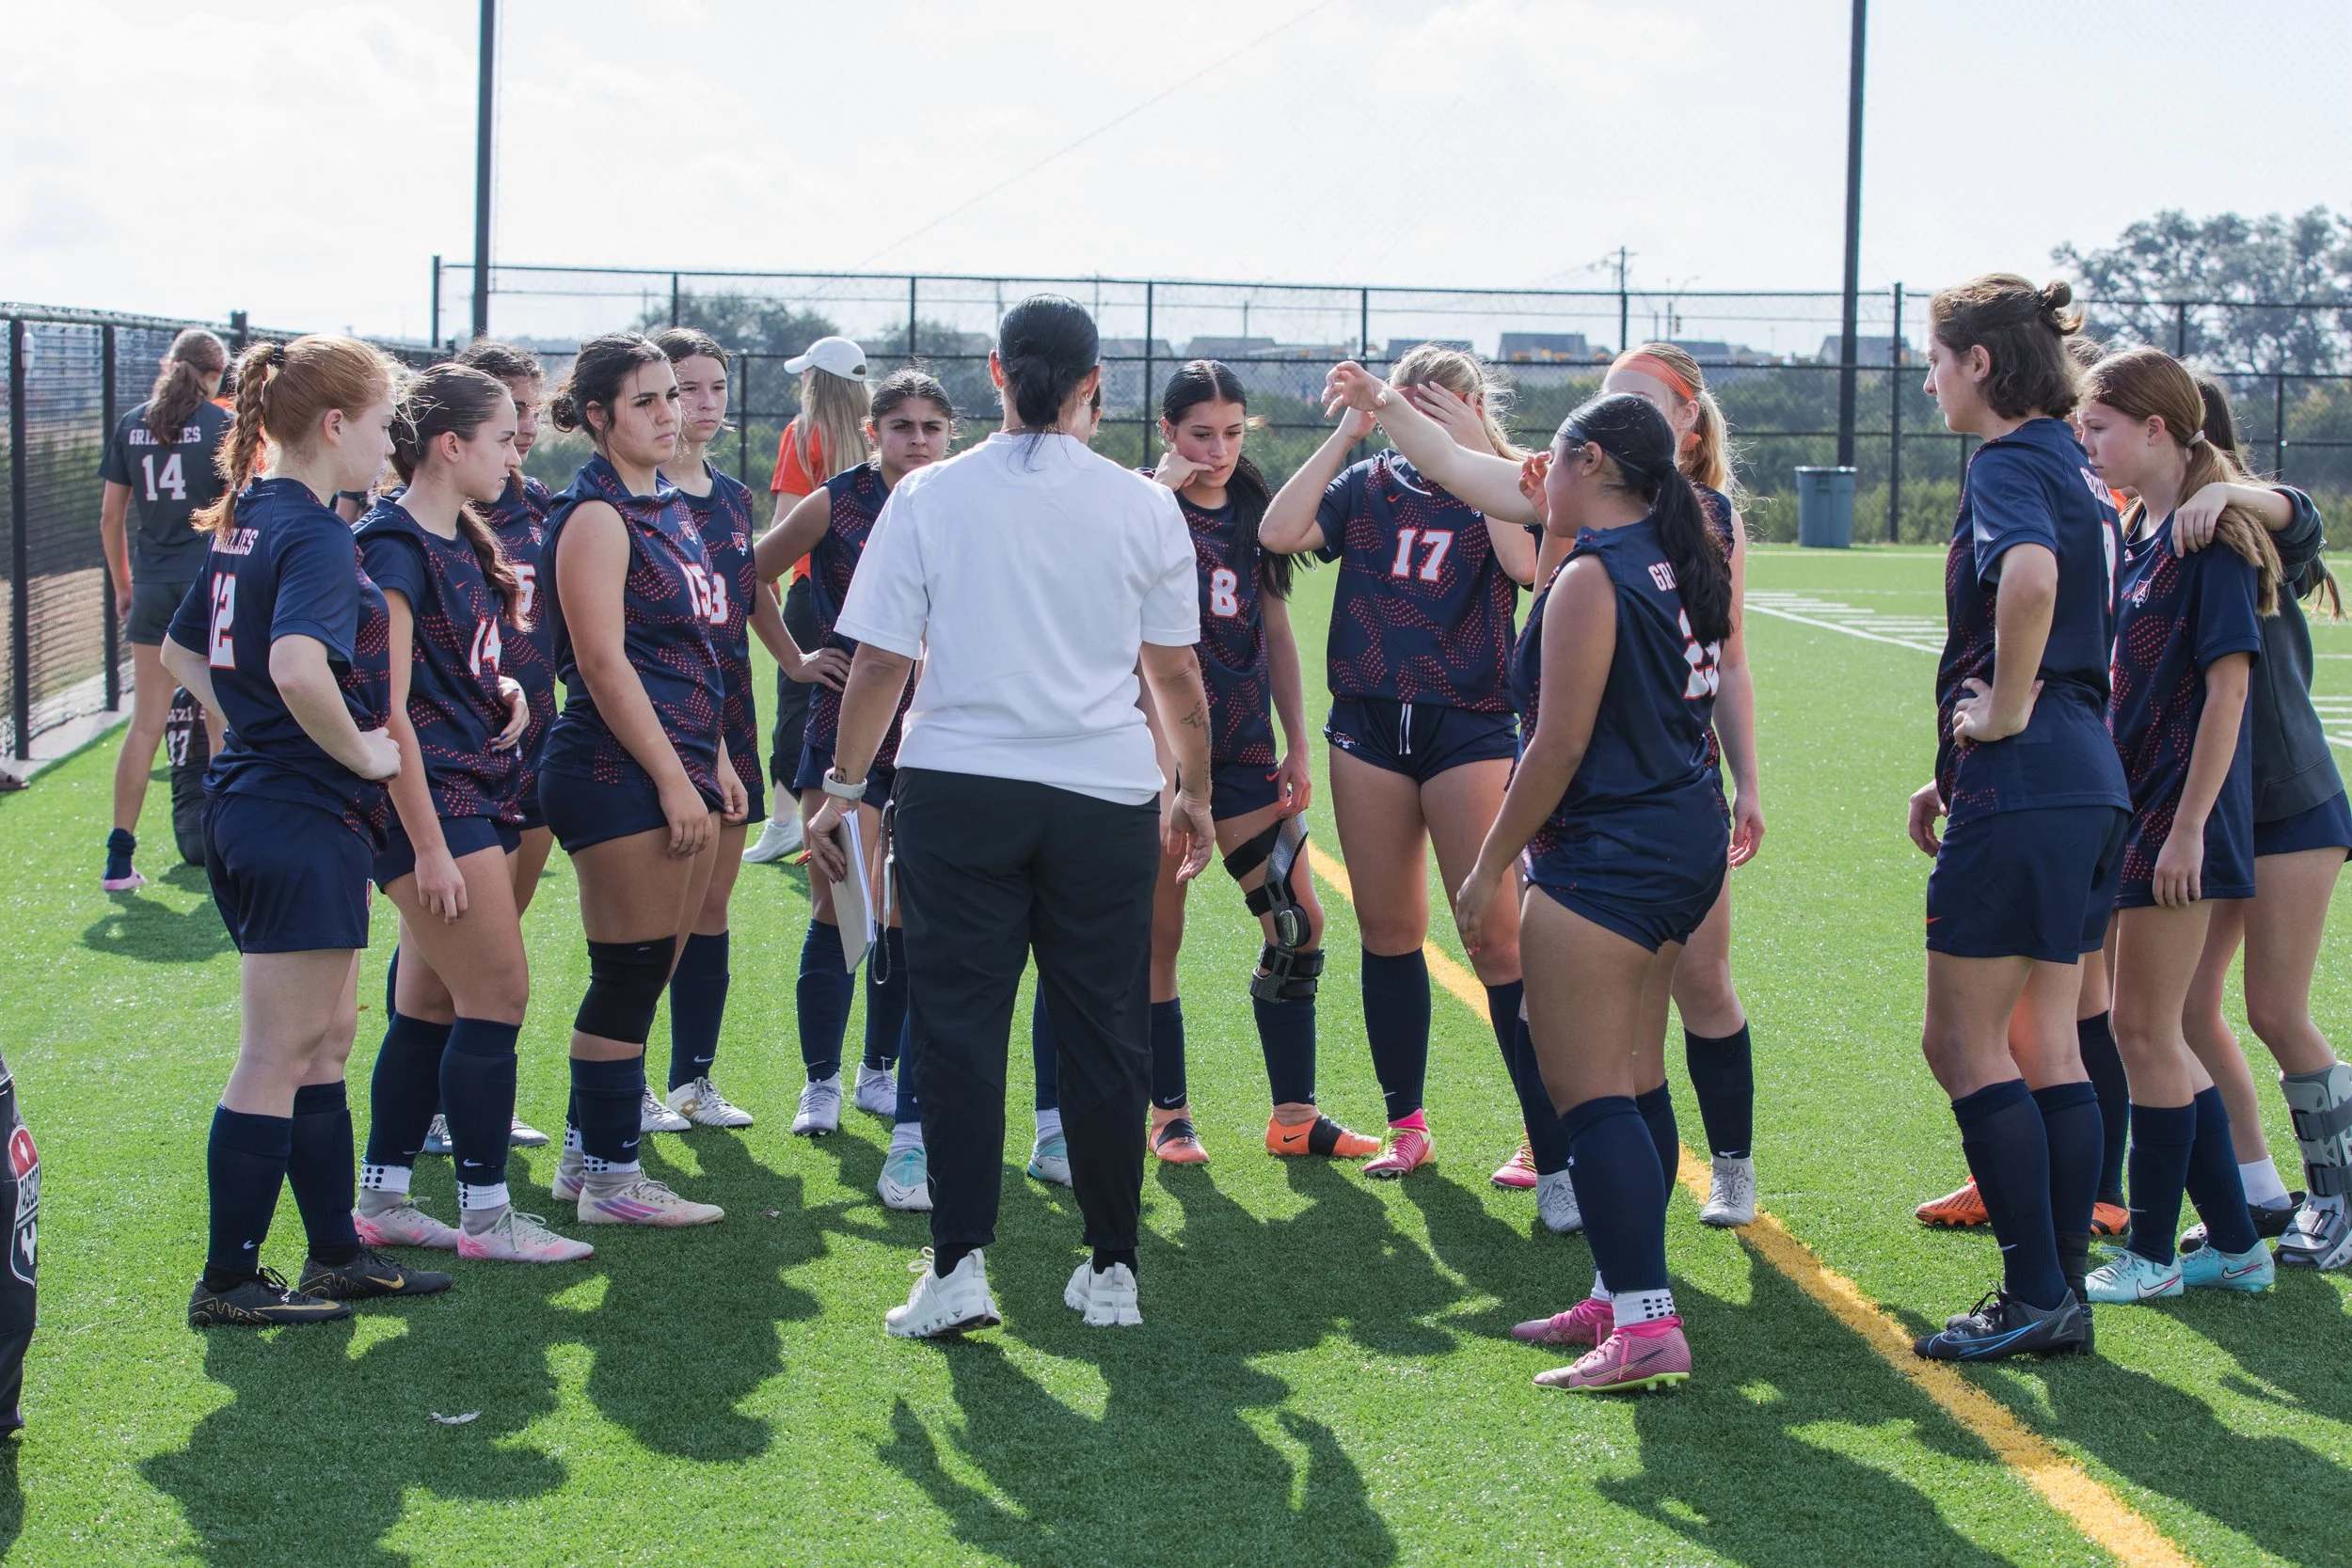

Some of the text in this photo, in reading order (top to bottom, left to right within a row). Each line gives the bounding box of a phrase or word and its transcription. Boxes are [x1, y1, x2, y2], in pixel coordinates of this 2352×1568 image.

[129, 426, 201, 445] GRIES
[141, 452, 186, 501] 14
[1391, 527, 1454, 582] 17
[679, 563, 712, 618] 15
[1210, 566, 1239, 618] 8
[209, 572, 236, 670] 12
[469, 615, 502, 677] 14
